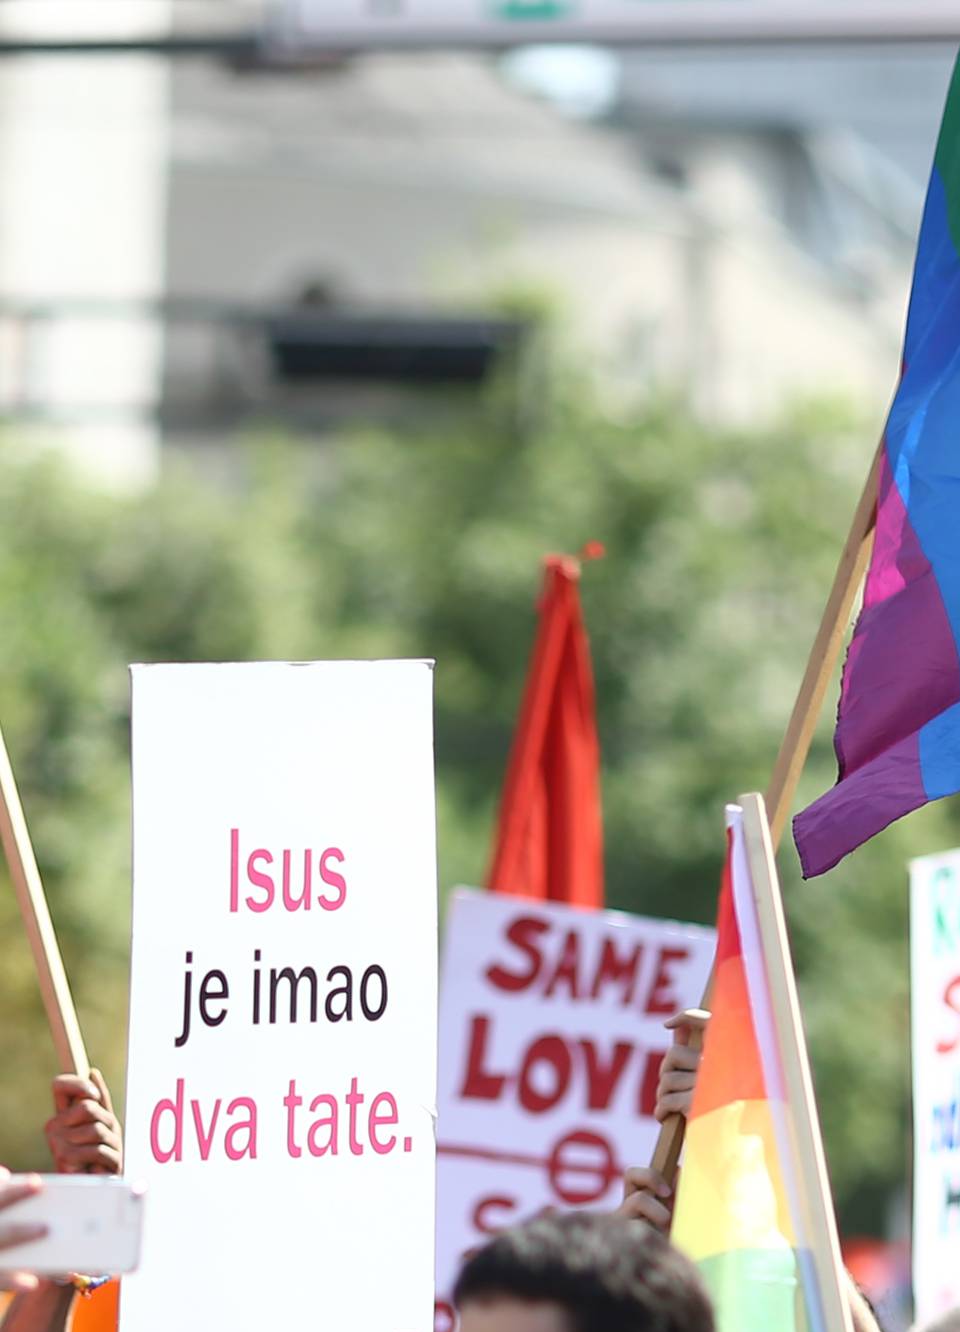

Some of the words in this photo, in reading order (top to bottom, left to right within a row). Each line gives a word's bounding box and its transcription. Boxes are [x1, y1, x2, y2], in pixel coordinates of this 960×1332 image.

[229, 828, 347, 913] Isus
[174, 950, 229, 1048] je
[252, 949, 389, 1025] imao
[485, 915, 690, 1015] SAME
[150, 1078, 258, 1164] dva
[283, 1076, 413, 1159] tate.
